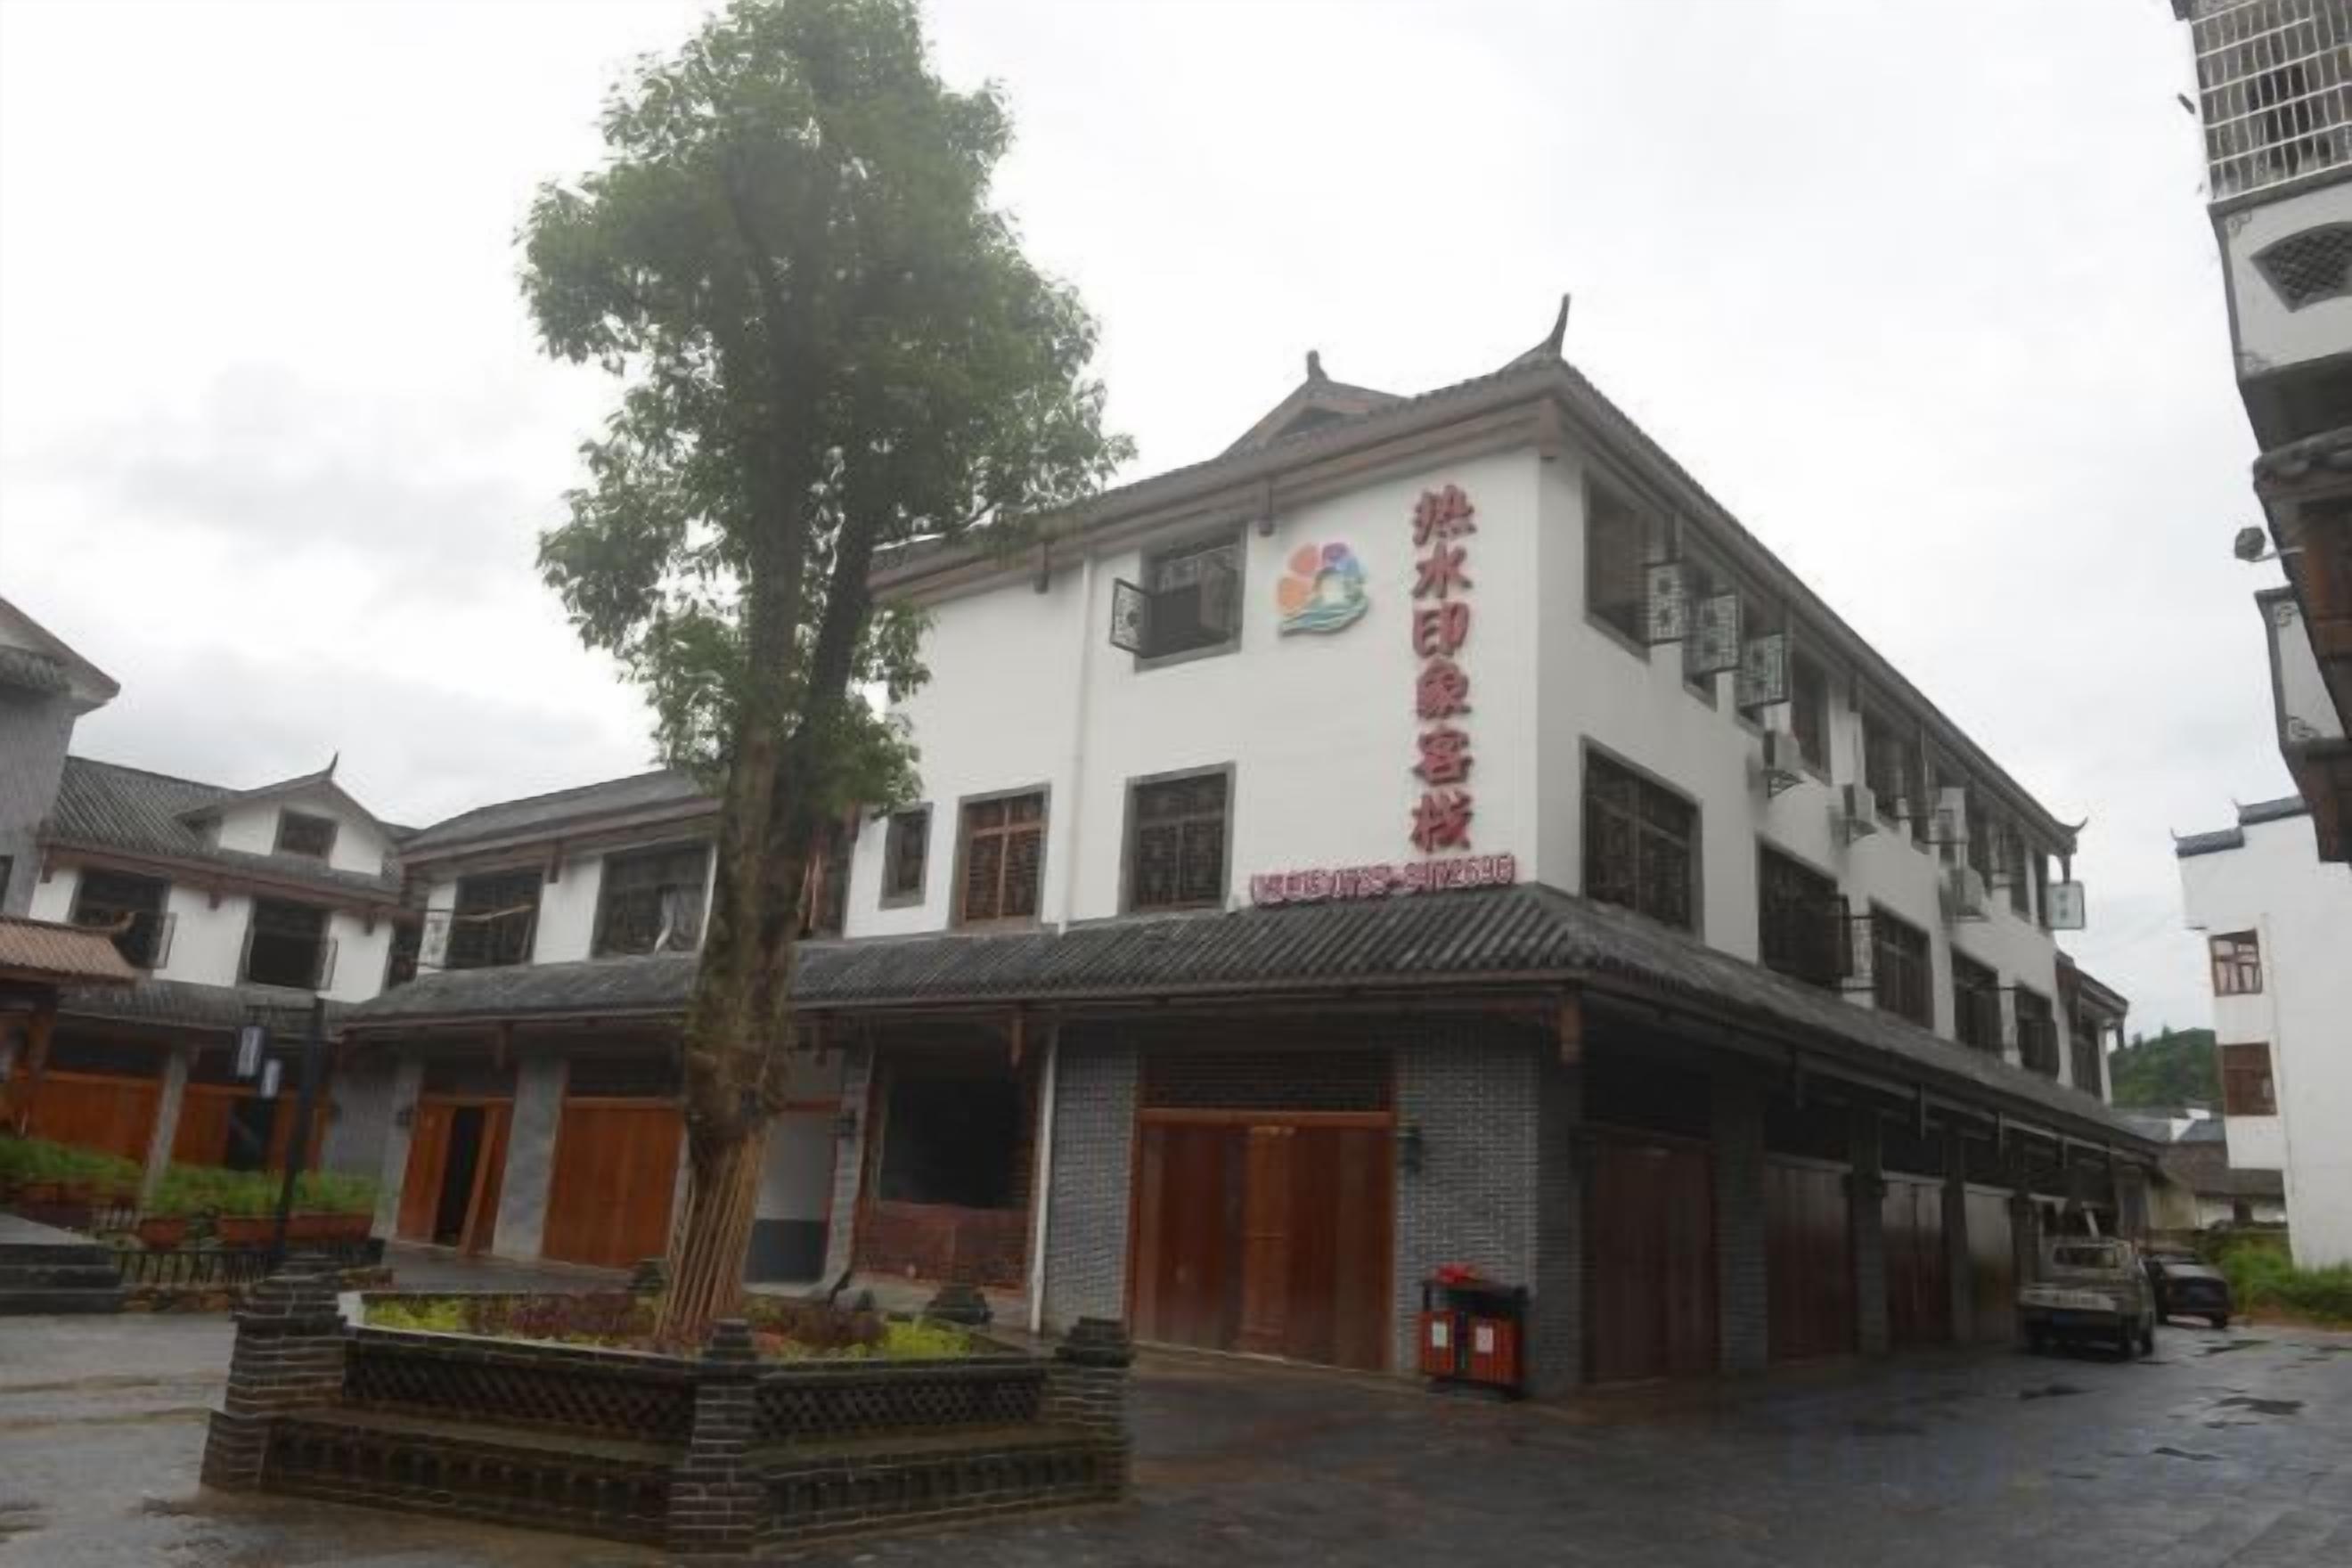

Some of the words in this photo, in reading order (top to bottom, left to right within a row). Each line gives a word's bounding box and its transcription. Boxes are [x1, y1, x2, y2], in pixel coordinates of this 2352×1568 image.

[1410, 484, 1477, 853] 热水印象客栈
